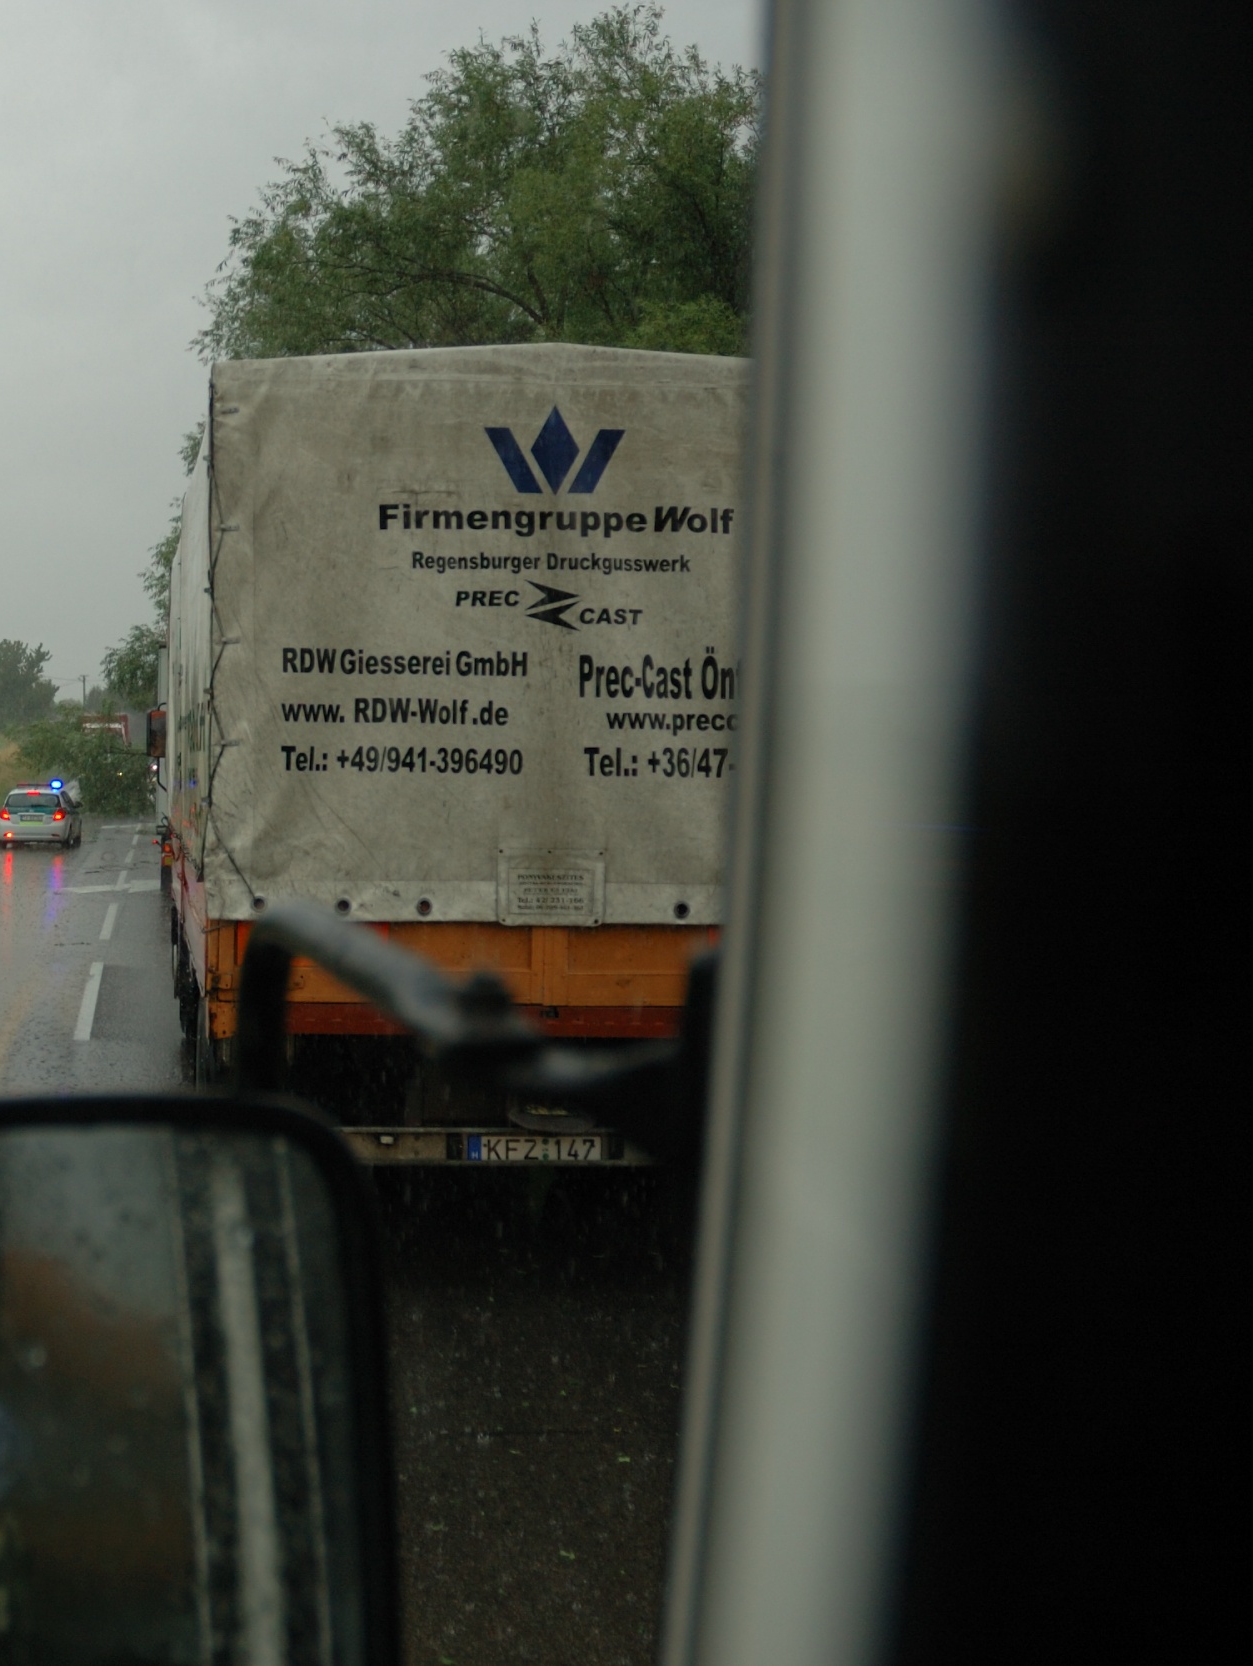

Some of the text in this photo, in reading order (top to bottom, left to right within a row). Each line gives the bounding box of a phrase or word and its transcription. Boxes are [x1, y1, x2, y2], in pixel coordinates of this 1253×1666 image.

[379, 504, 734, 538] Firmengruppe Wolf
[412, 551, 691, 575] Regensburger Druckgusswerk
[455, 590, 520, 607] PREC
[579, 608, 643, 625] CAST
[282, 648, 528, 677] RDW Giesserei GmbH
[579, 654, 692, 699] Prec-Cast
[281, 745, 523, 775] Tel.: +49/941-396490
[584, 747, 638, 777] Tel.:
